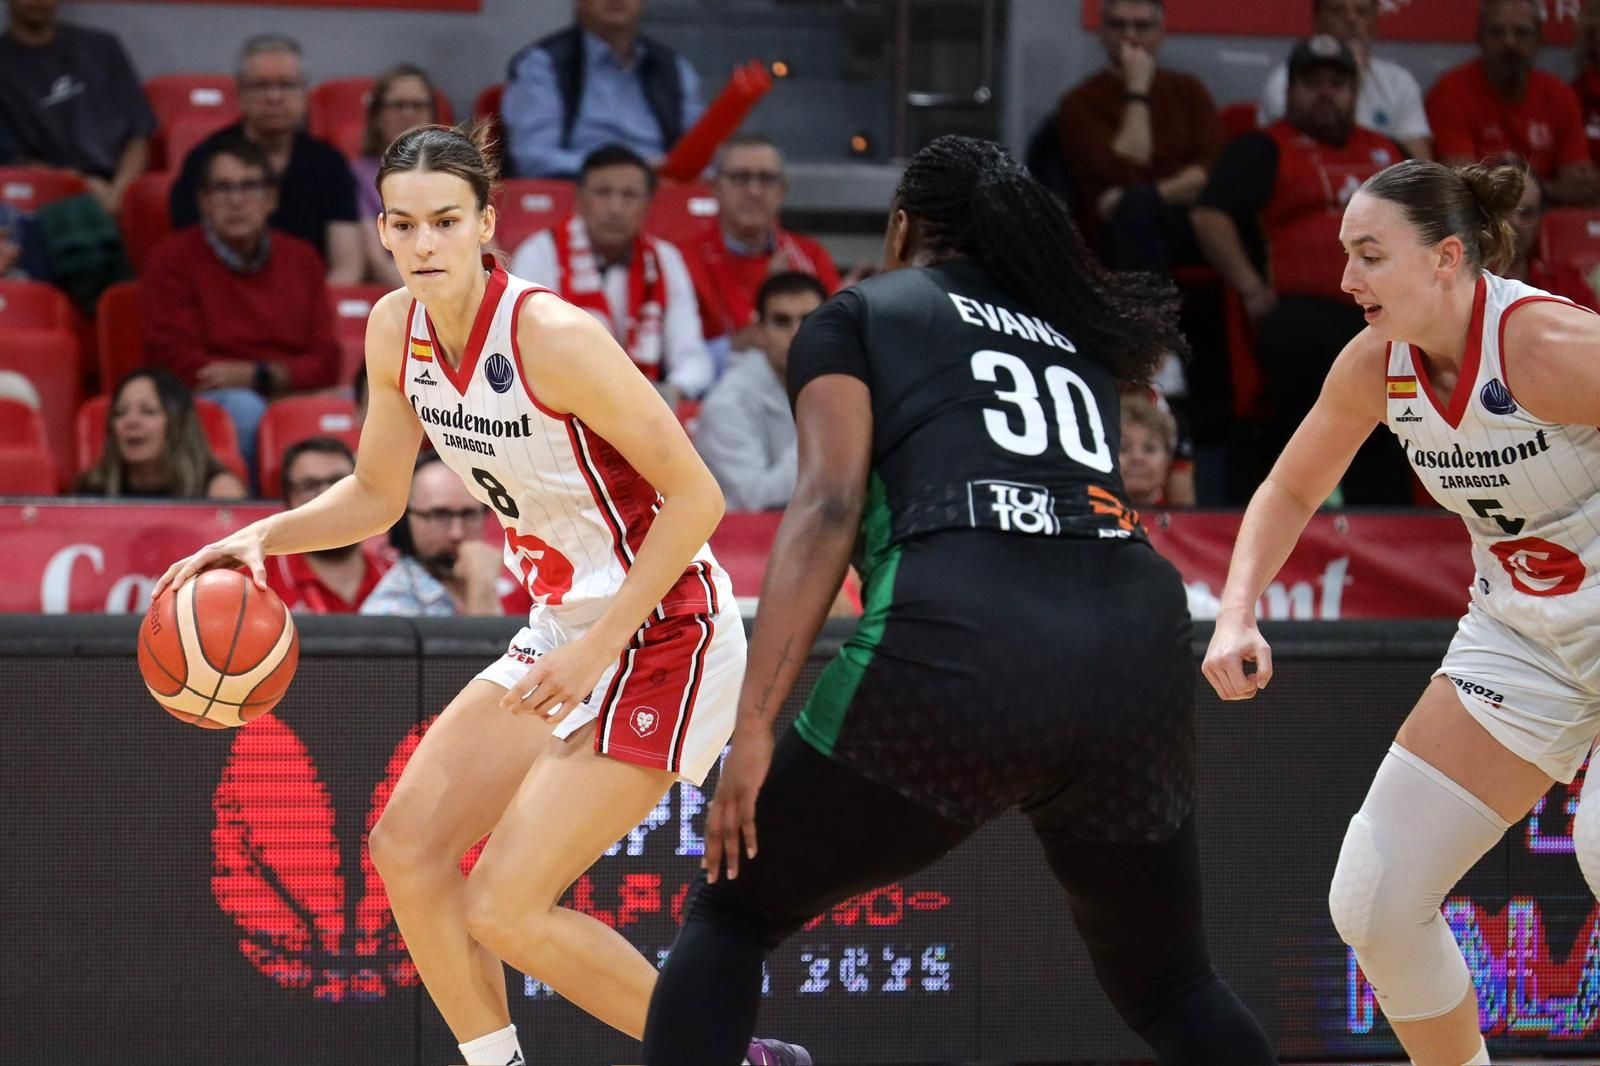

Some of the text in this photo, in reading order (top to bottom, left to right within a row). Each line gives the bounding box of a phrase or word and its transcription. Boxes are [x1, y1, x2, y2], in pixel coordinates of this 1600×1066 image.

[948, 292, 1077, 353] EVANS
[970, 350, 1113, 474] 30
[443, 433, 496, 457] ZARAGOZA
[471, 466, 520, 520] 8
[1439, 474, 1510, 489] ZARAGOZA
[1466, 499, 1526, 536] 5
